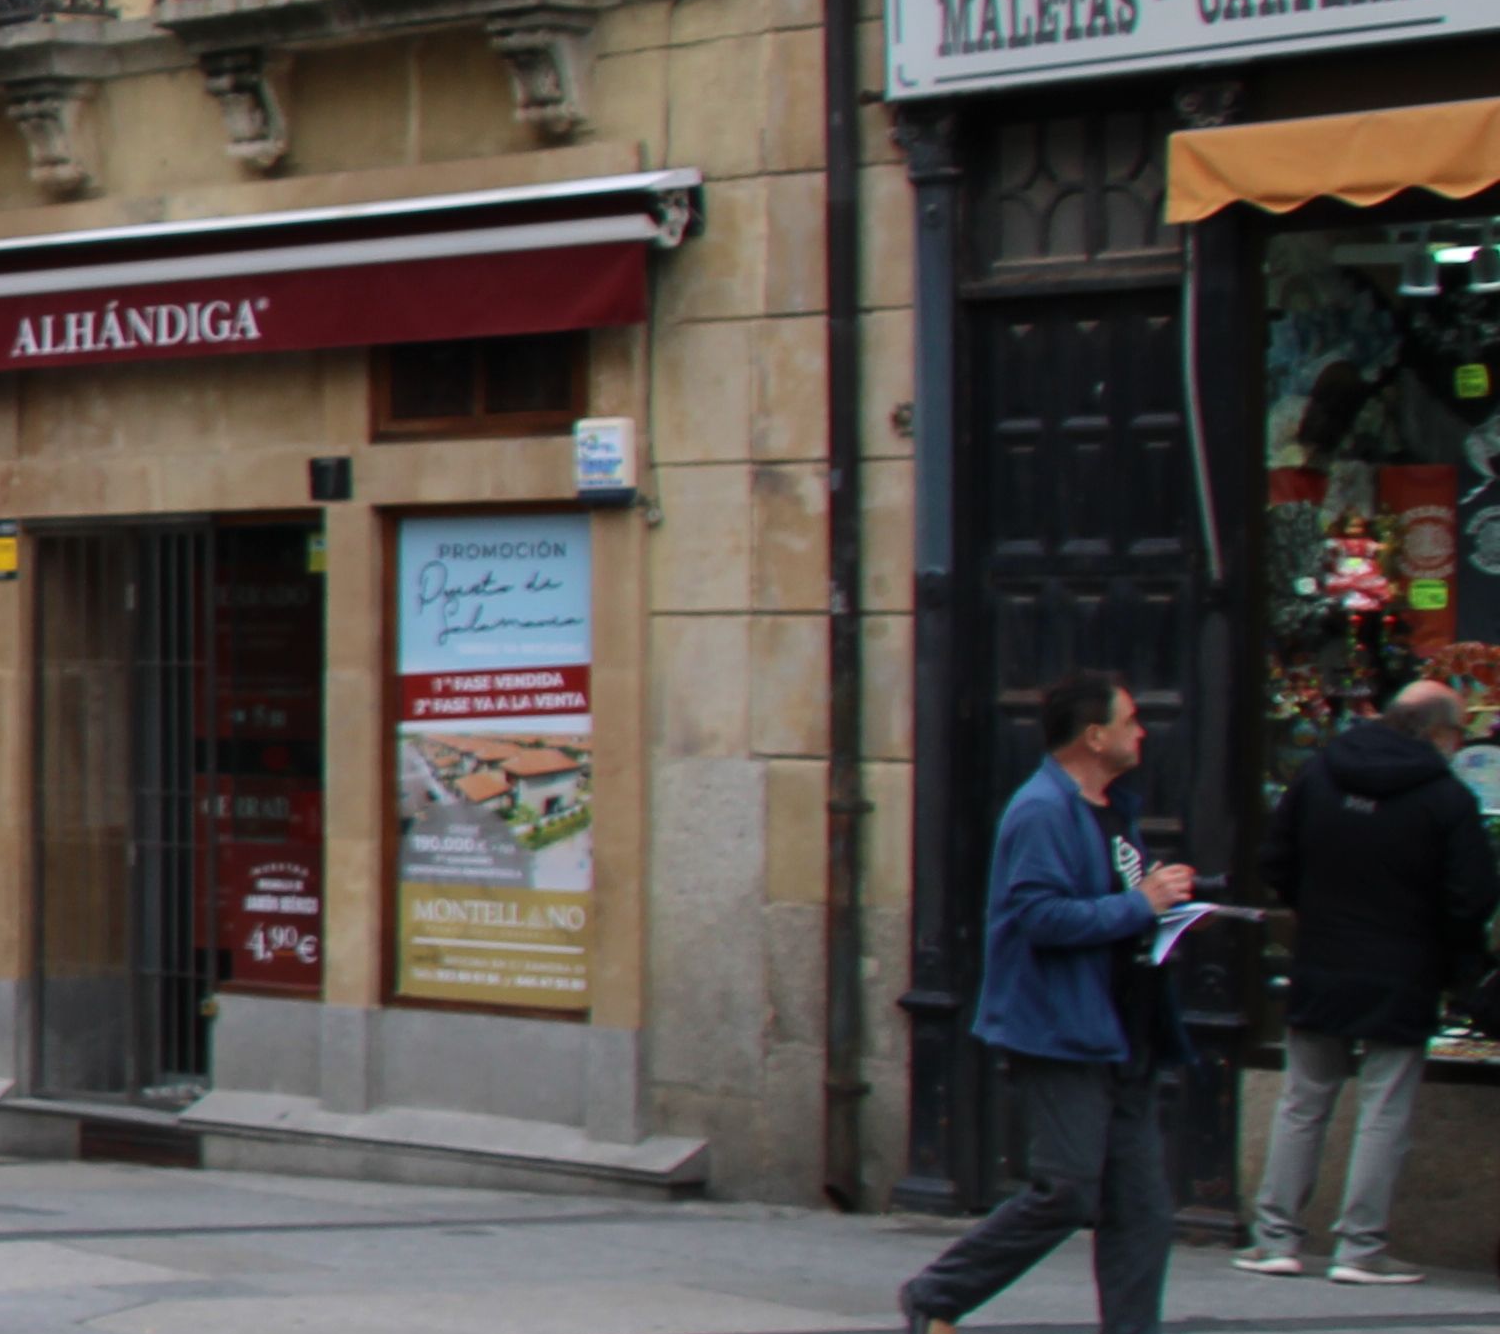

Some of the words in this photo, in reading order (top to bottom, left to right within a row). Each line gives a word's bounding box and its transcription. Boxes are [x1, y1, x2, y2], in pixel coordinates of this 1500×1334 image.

[438, 540, 567, 560] PROMOCIÓN
[453, 674, 491, 692] FASE
[493, 671, 565, 689] VENDIDA
[432, 696, 471, 714] FASE
[509, 693, 534, 708] LA
[534, 690, 587, 708] VENTA
[411, 897, 586, 933] MONTELLANO
